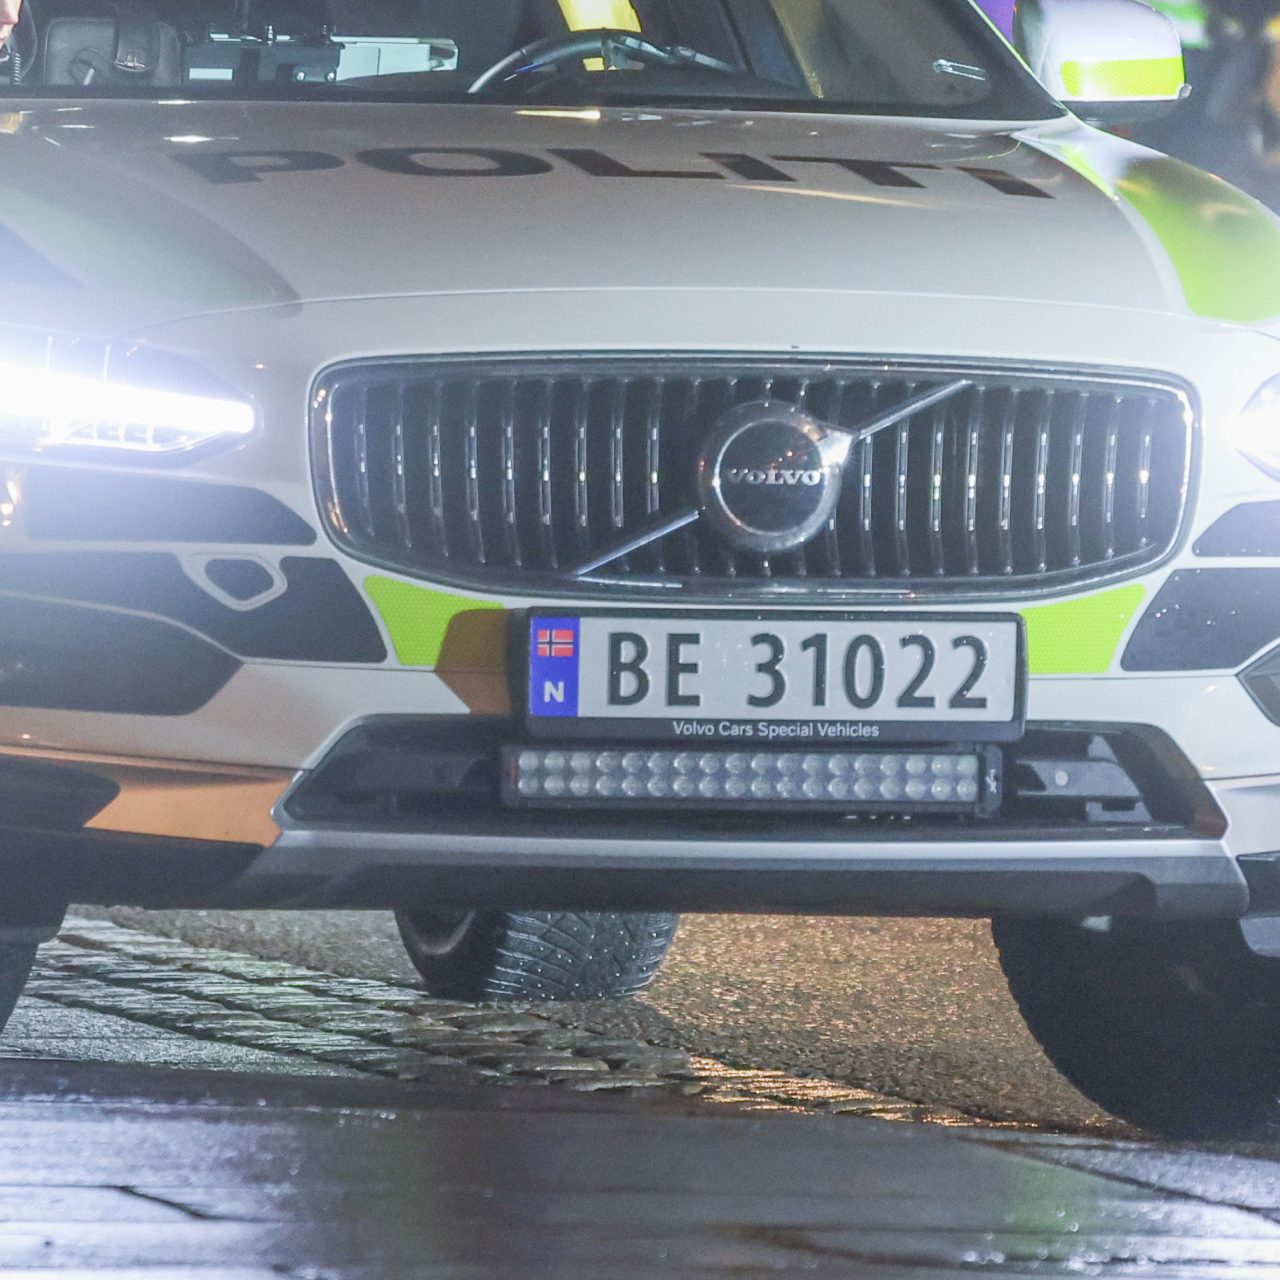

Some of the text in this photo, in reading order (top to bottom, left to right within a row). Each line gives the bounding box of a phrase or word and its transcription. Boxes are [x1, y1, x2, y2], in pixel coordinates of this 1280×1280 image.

[167, 146, 1055, 200] POLITI
[728, 468, 821, 486] VOLVO
[607, 631, 989, 710] BE 31022
[543, 680, 566, 703] N
[672, 720, 880, 740] Volvo Cars Special Vehicles
